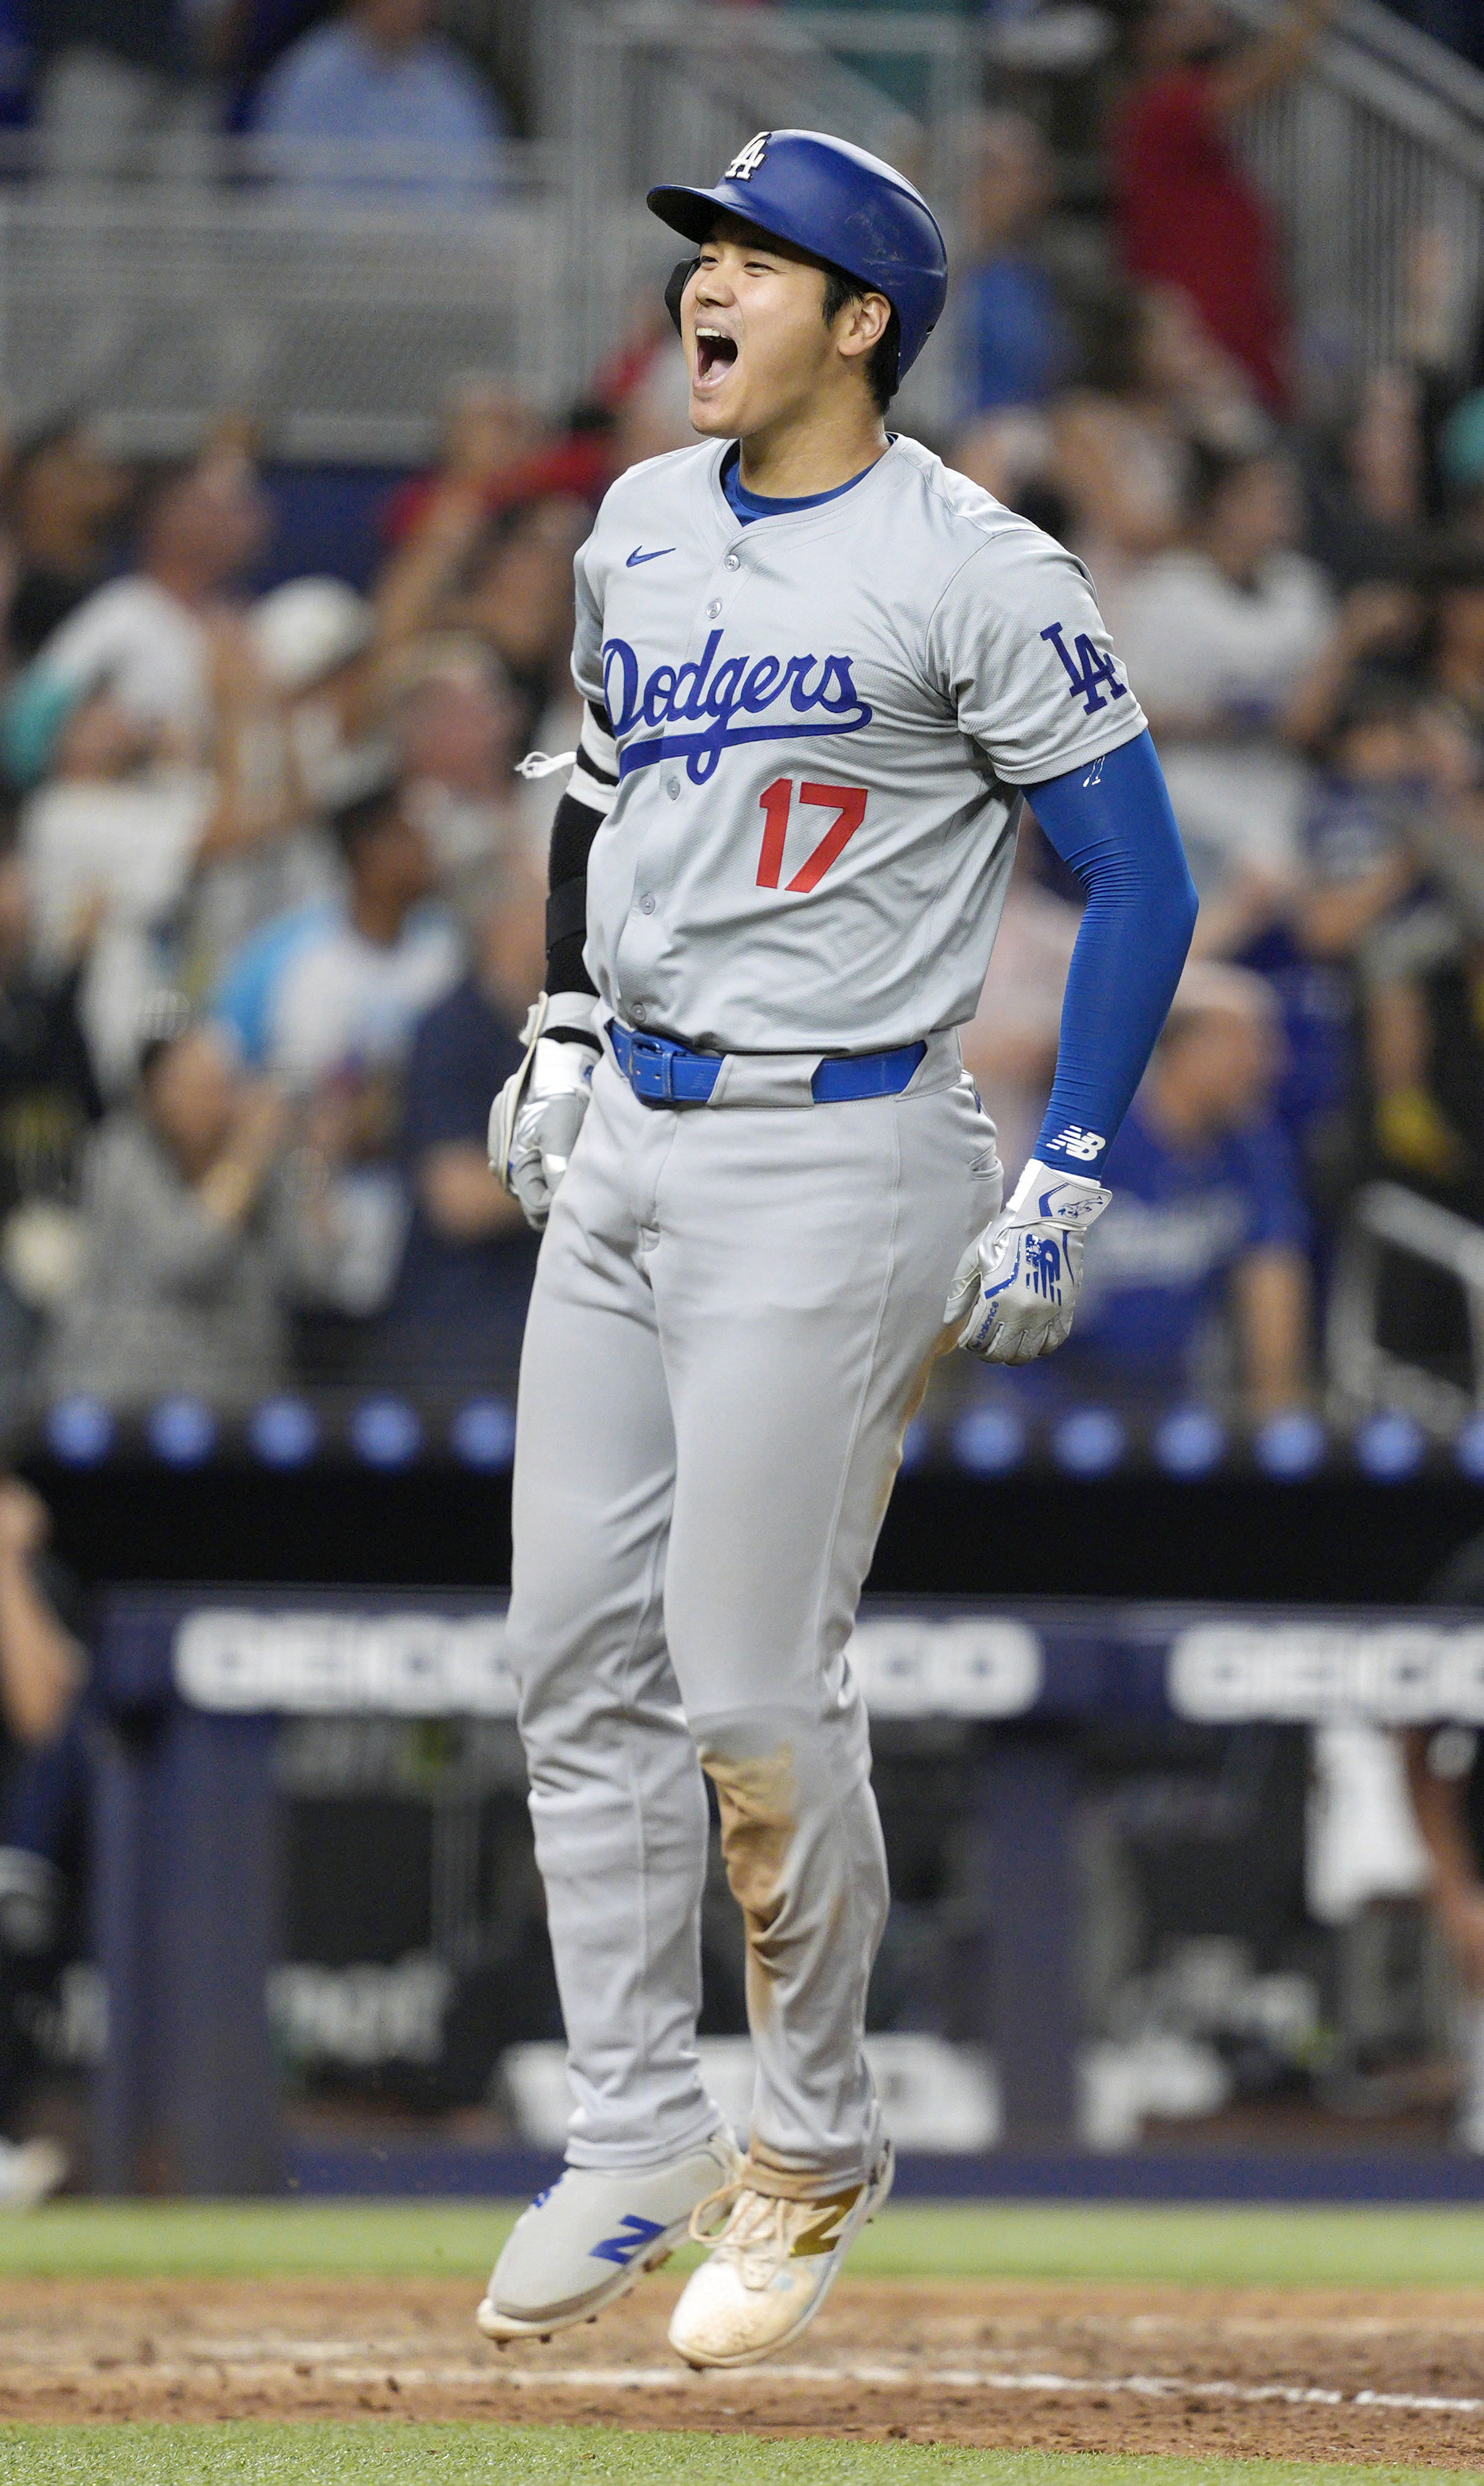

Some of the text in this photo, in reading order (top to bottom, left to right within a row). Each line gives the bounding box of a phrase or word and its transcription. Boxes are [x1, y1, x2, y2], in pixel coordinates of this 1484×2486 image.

[725, 132, 772, 181] LA
[603, 629, 872, 785] Dodgers
[1040, 622, 1127, 716] LA
[756, 778, 868, 893] 17
